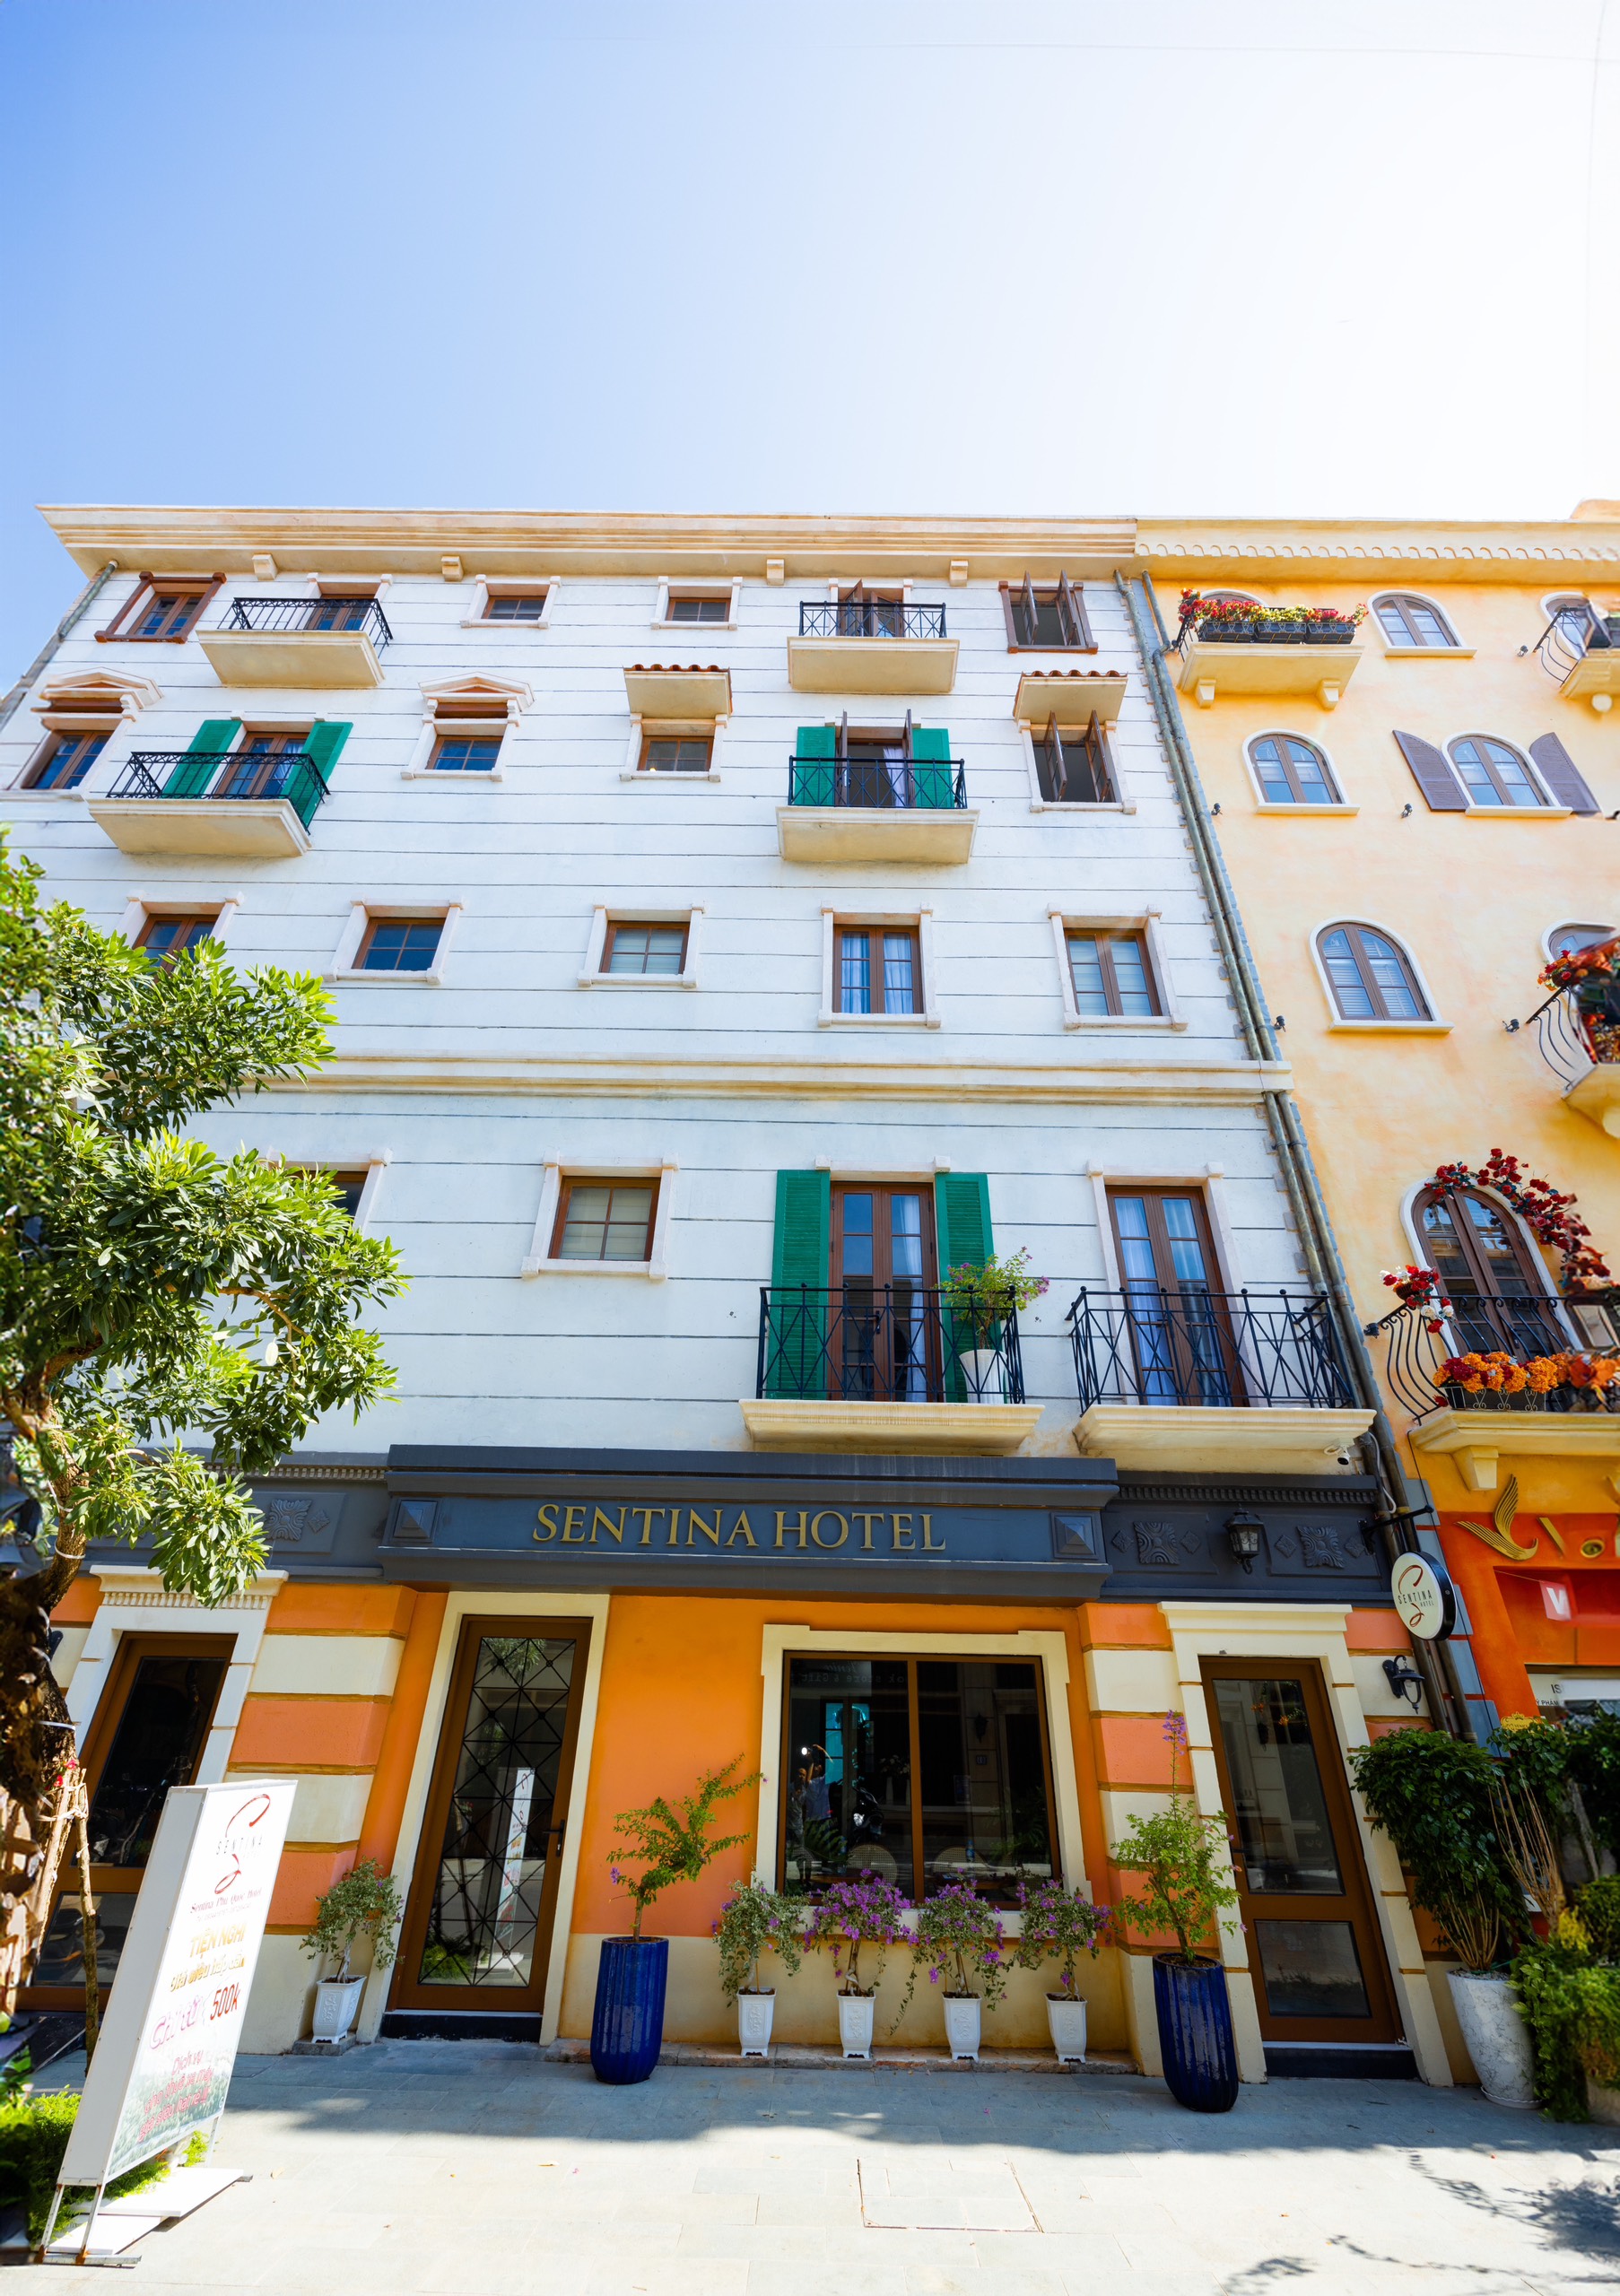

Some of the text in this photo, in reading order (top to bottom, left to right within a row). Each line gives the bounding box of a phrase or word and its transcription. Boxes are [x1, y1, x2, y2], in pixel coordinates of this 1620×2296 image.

[533, 1503, 947, 1552] SENTINA HOTEL
[1398, 1589, 1433, 1605] SENTINA
[1420, 1599, 1434, 1607] HOTEL
[216, 1834, 263, 1856] SENTINA
[210, 1982, 241, 2021] 500k
